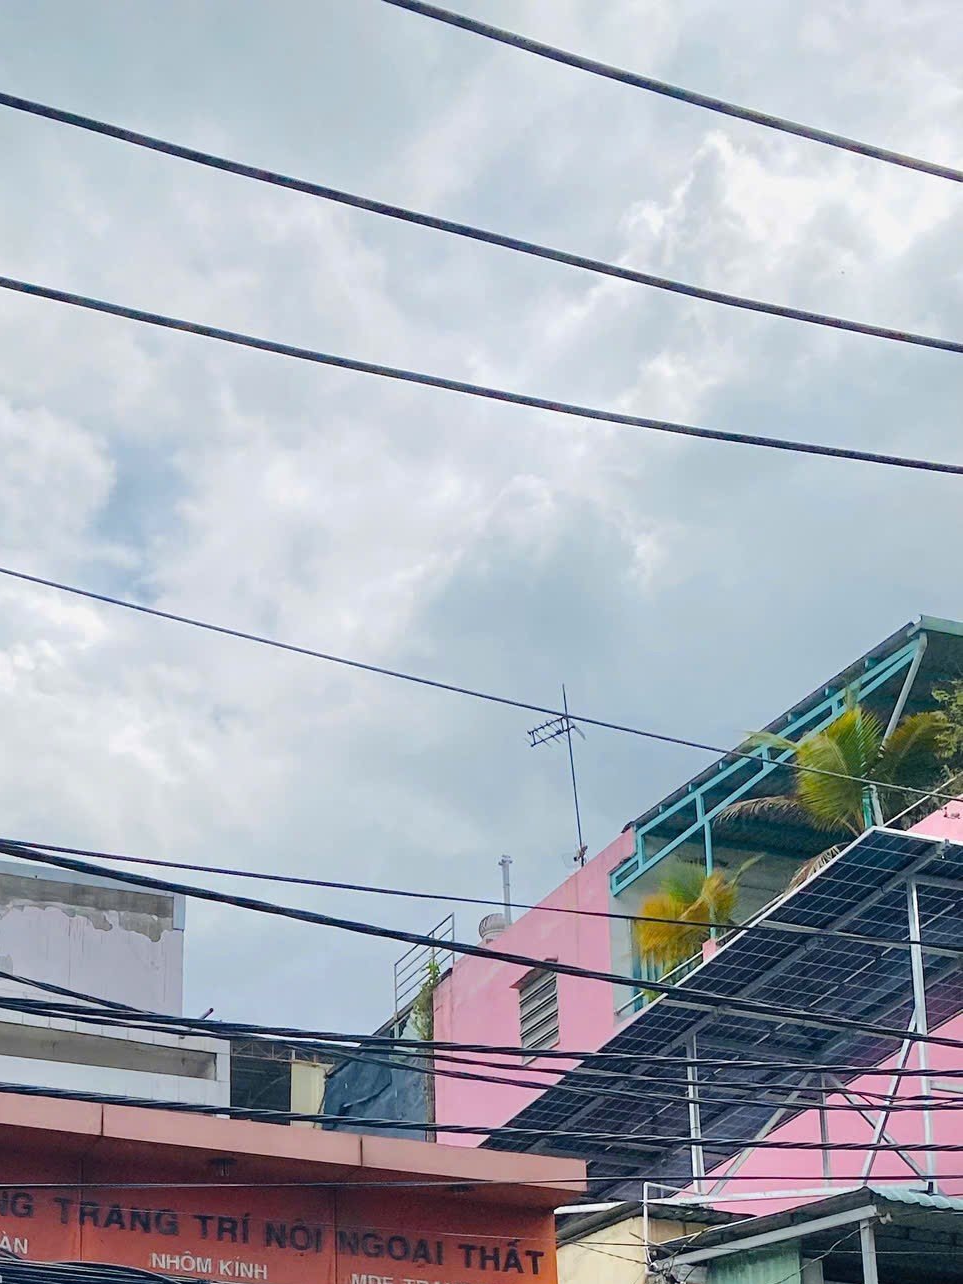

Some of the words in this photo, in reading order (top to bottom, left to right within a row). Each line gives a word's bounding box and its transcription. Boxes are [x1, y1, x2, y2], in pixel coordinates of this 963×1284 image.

[54, 1197, 180, 1236] TRANG
[193, 1213, 251, 1244] TRÍ
[458, 1237, 545, 1275] THẤT
[150, 1250, 212, 1274] NHÔM
[218, 1256, 268, 1281] KÍNH
